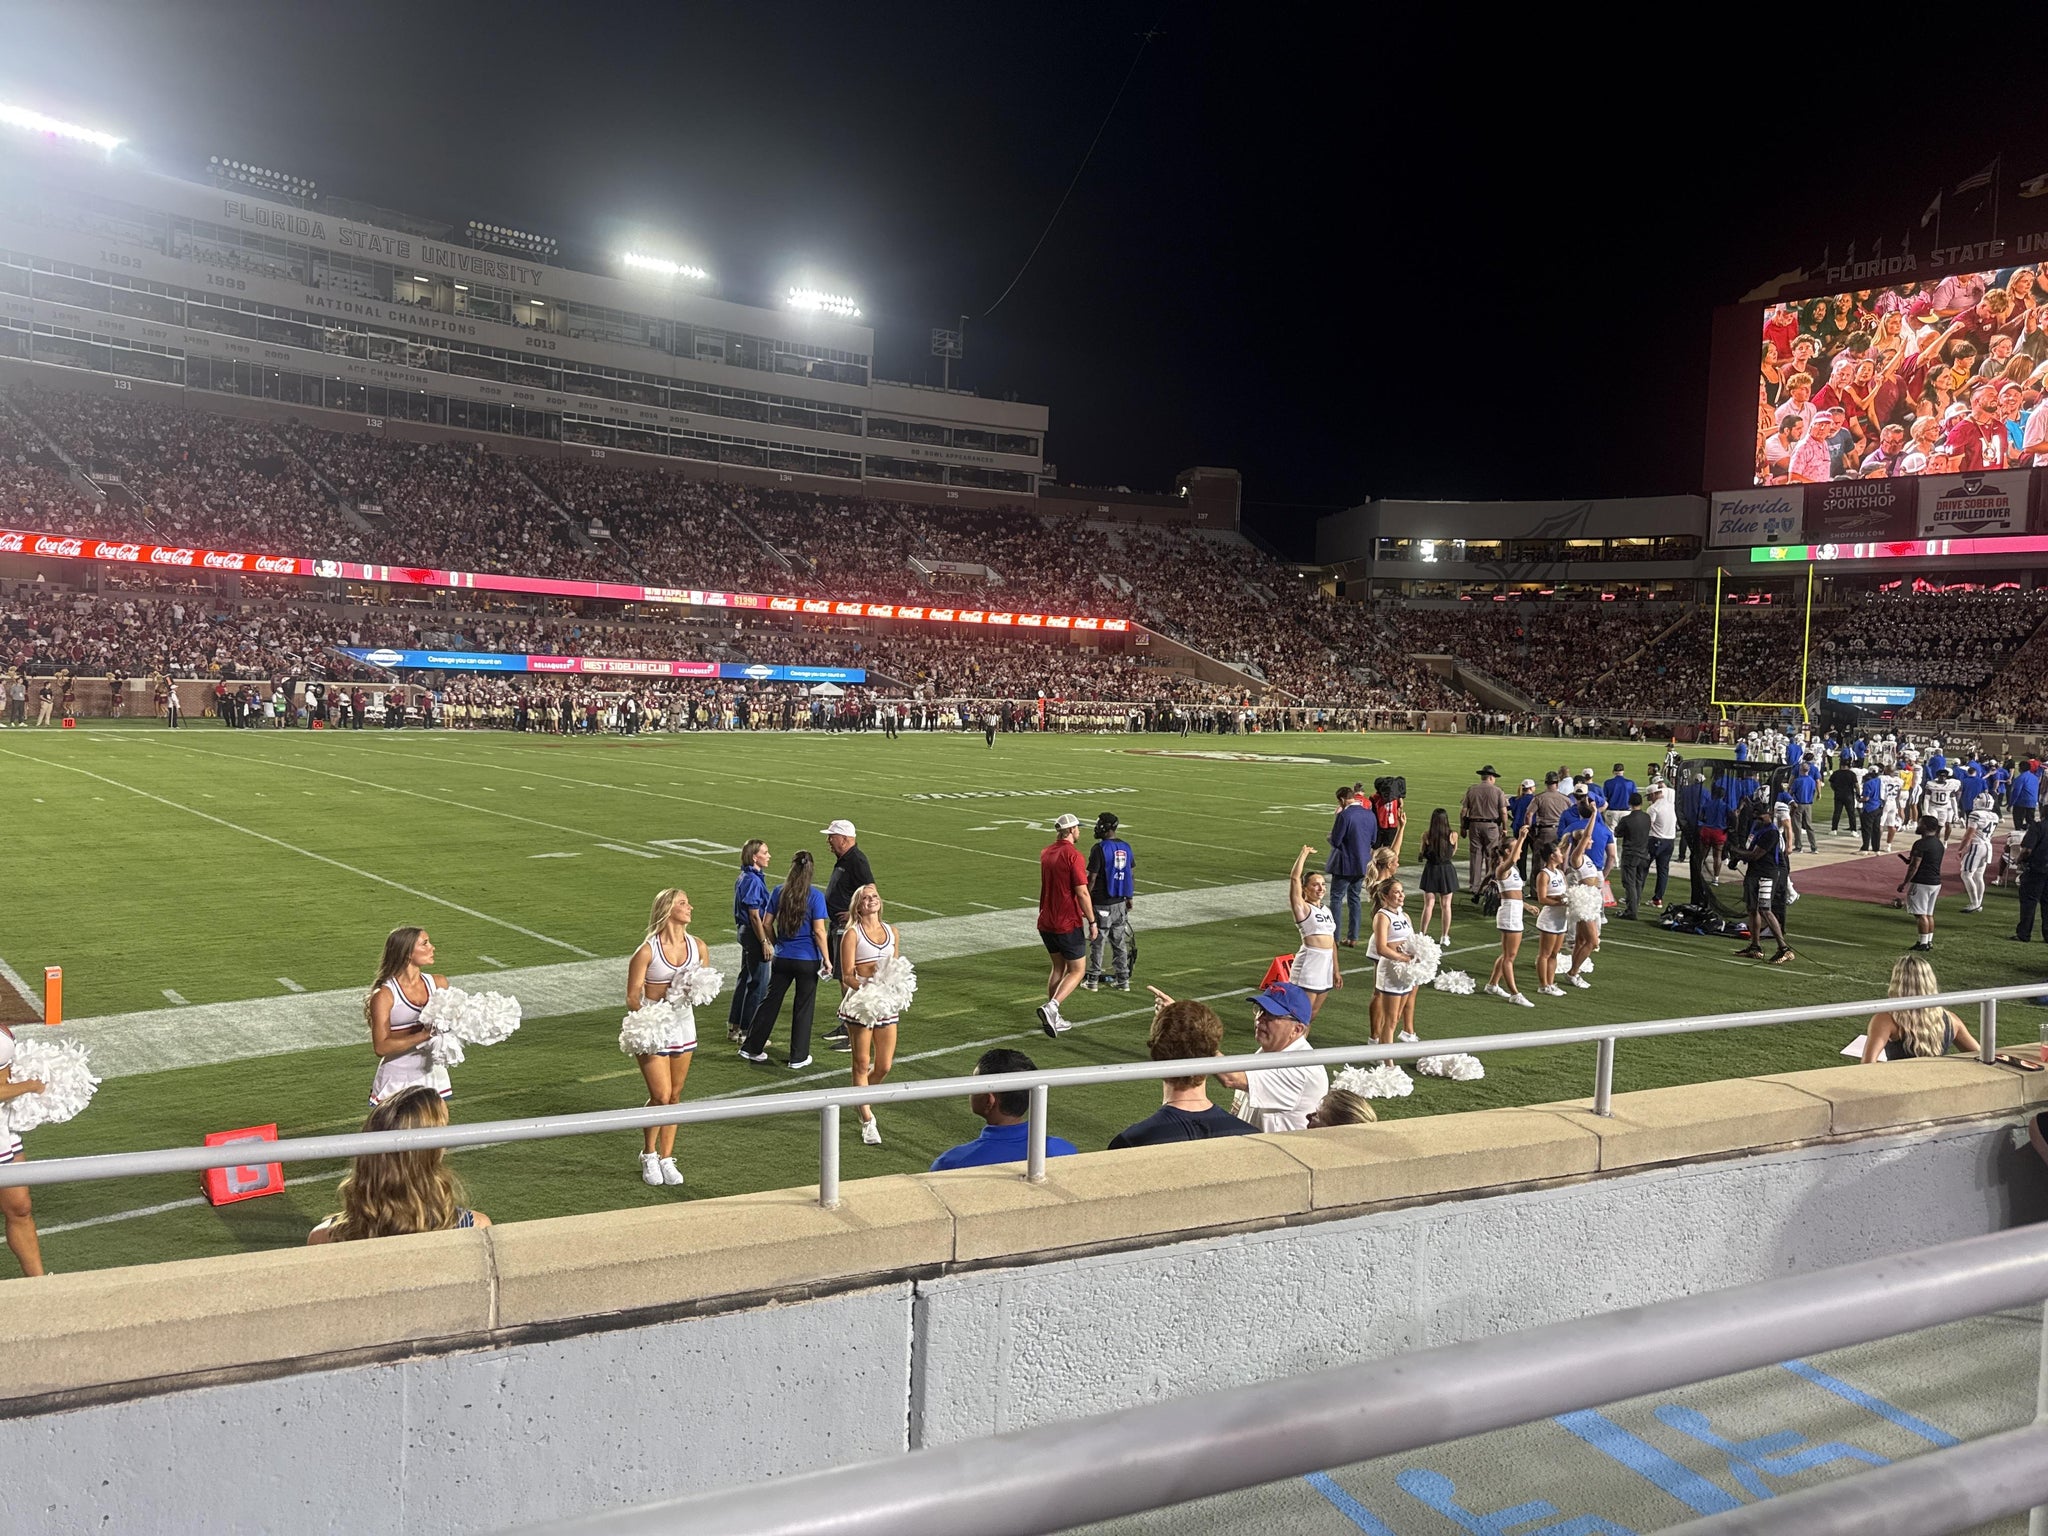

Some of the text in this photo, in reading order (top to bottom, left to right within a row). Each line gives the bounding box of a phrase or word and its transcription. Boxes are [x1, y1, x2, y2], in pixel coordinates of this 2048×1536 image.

[224, 200, 543, 286] FLORIDA STATE UNIVERSITY
[1827, 254, 1918, 285] FLORIDA
[1930, 239, 2006, 268] STATE
[305, 294, 382, 318] NATIONAL
[388, 310, 477, 336] CHAMPIONS
[525, 336, 557, 350] 2013
[370, 367, 429, 384] CHAMPIONS
[113, 379, 132, 391] 131
[366, 417, 383, 428] 132
[591, 449, 605, 458] 133
[780, 474, 792, 482] 134
[1828, 483, 1892, 499] SEMINOLE
[1719, 497, 1792, 516] Florida
[1823, 495, 1896, 511] SPORTSHOP
[1936, 497, 2009, 511] DRIVE SOBER OR
[1933, 508, 2010, 521] GET PULLED OVER
[1717, 517, 1759, 534] Blue
[1830, 530, 1886, 539] SHOPFSU.COM
[363, 564, 459, 586] 0 0
[427, 656, 455, 665] Coverage
[455, 657, 466, 665] you
[534, 662, 572, 670] RELIAQUEST
[583, 660, 670, 673] WEST SIDELINE CLUB
[678, 667, 711, 675] RELIAQUEST
[64, 719, 73, 727] 10
[1887, 783, 1900, 797] 23
[1935, 792, 1946, 802] 10
[1982, 821, 1998, 837] 47
[592, 838, 744, 859] 10
[223, 1135, 270, 1194] G
